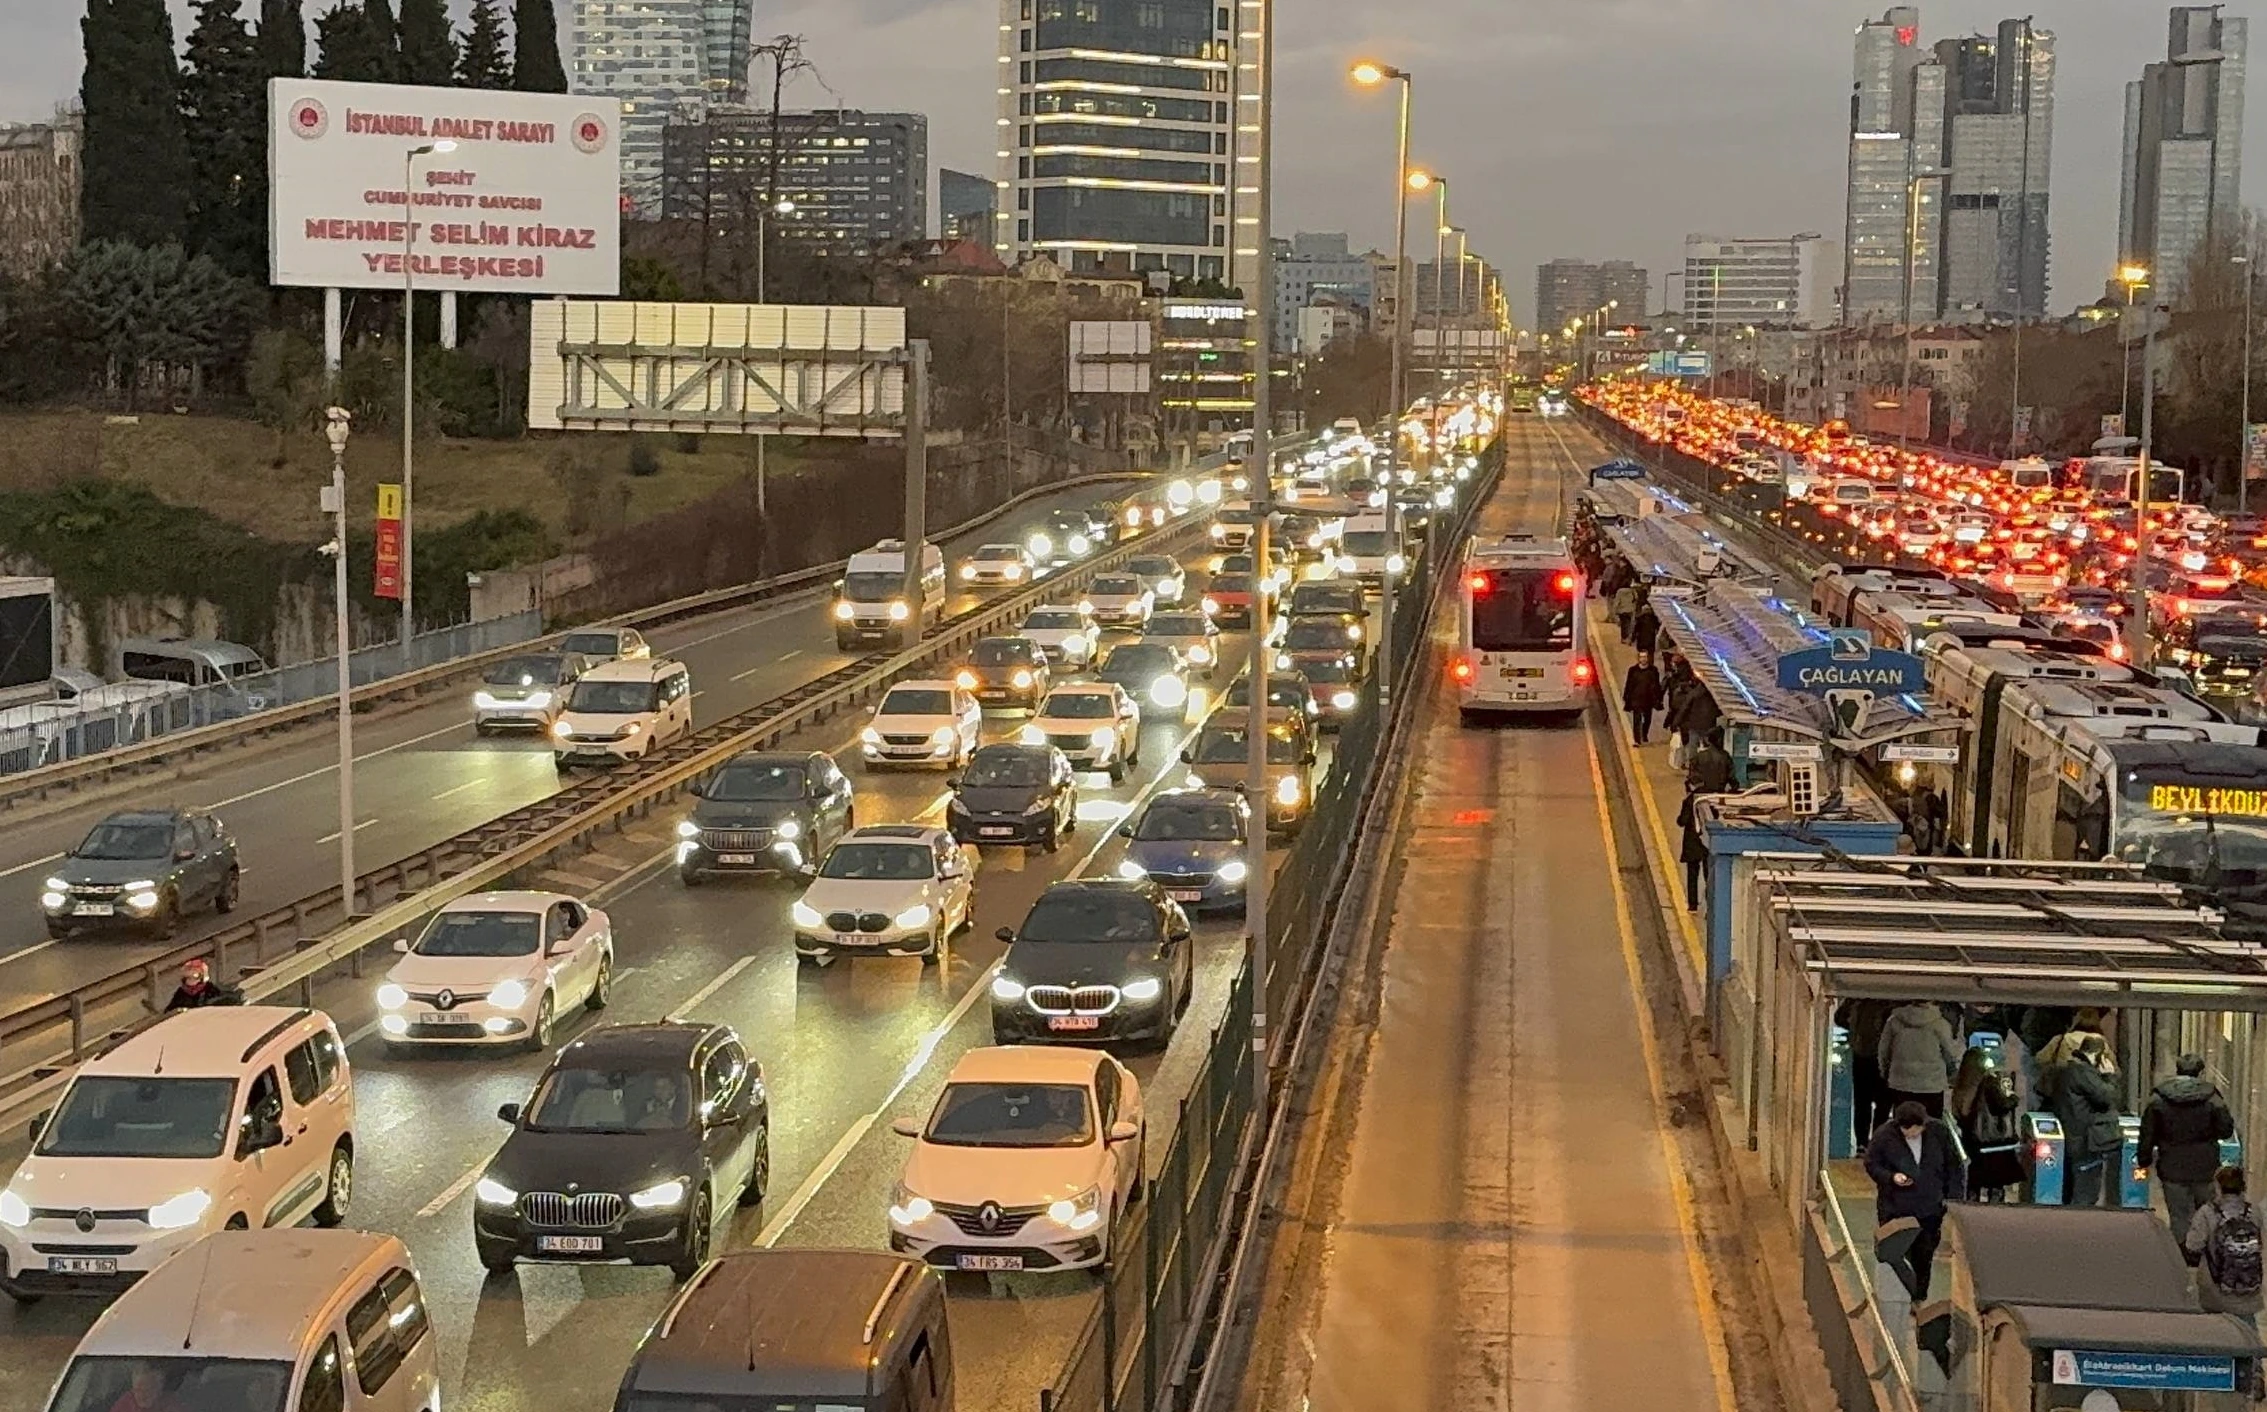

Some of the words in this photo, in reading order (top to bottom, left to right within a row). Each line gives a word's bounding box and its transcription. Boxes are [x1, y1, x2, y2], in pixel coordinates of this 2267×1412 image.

[346, 107, 427, 136] İSTANBUL
[431, 117, 494, 140] ADALET
[497, 120, 554, 144] SARAYI
[426, 169, 476, 187] ŞEHİT
[363, 189, 475, 208] CUMHURİYET
[478, 195, 542, 211] SAVCISI
[305, 218, 422, 242] MEHMET
[430, 220, 509, 246] SELİM
[517, 223, 596, 249] KİRAZ
[362, 252, 544, 280] YERLEŞKESİ
[1799, 665, 1903, 688] ÇAĞLAYAN
